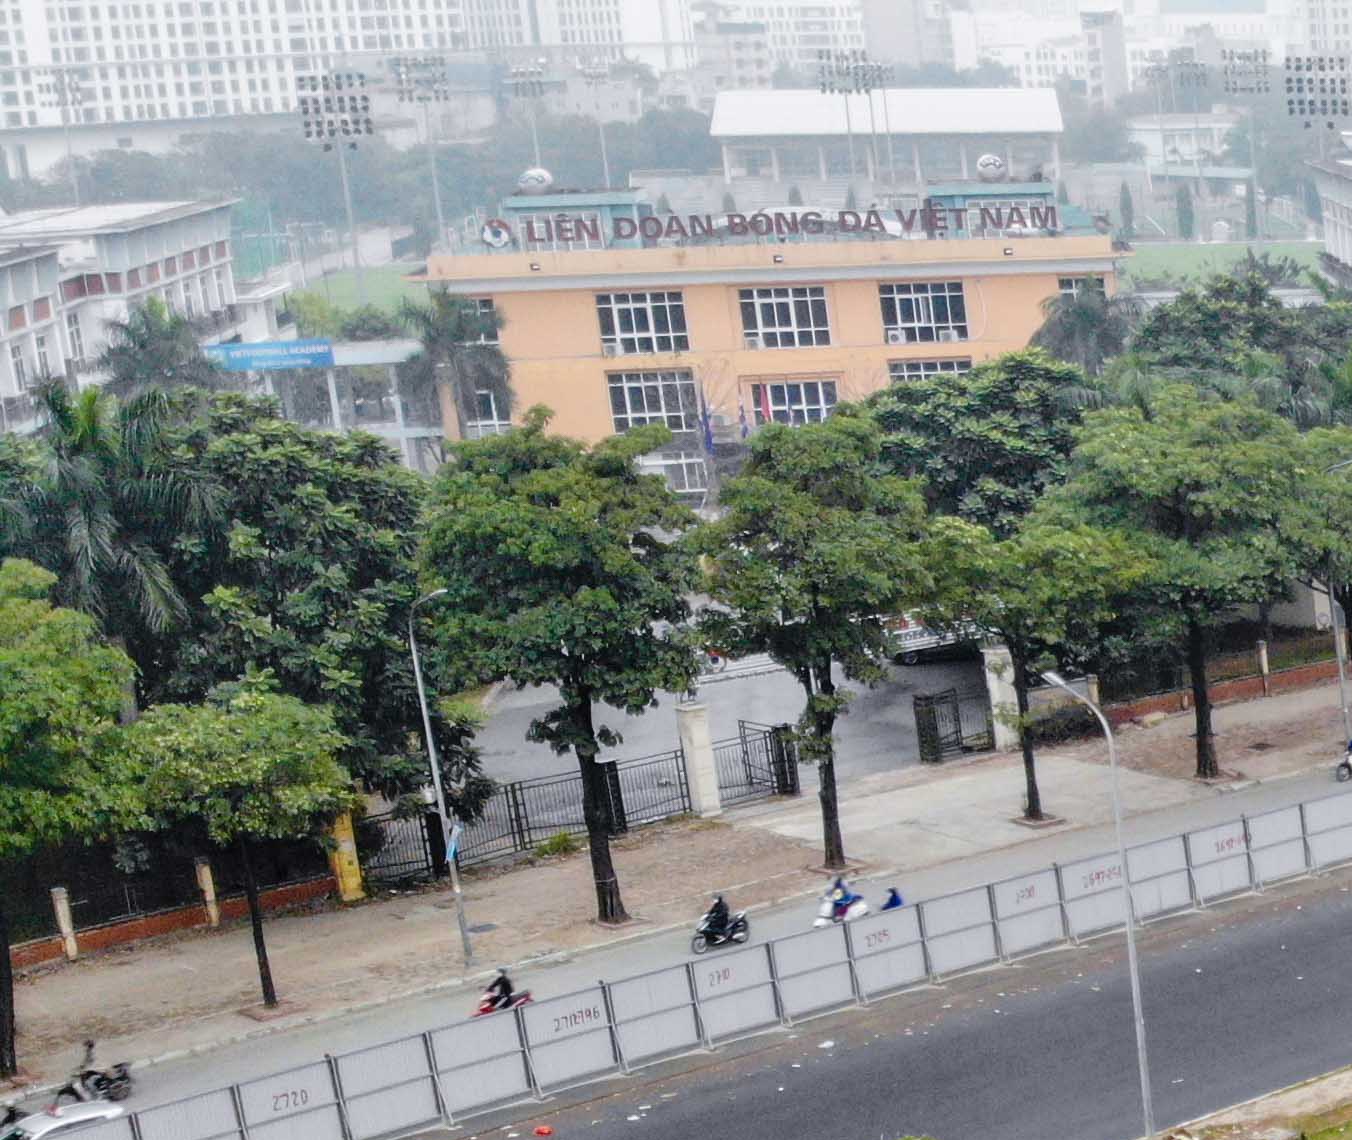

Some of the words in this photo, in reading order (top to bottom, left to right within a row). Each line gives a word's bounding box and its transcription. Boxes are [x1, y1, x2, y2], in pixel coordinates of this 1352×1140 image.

[524, 212, 600, 244] LIÊN
[726, 207, 824, 236] BÓNG
[893, 201, 969, 237] VIỆT
[980, 205, 1059, 229] NAM
[271, 1088, 310, 1112] 2720
